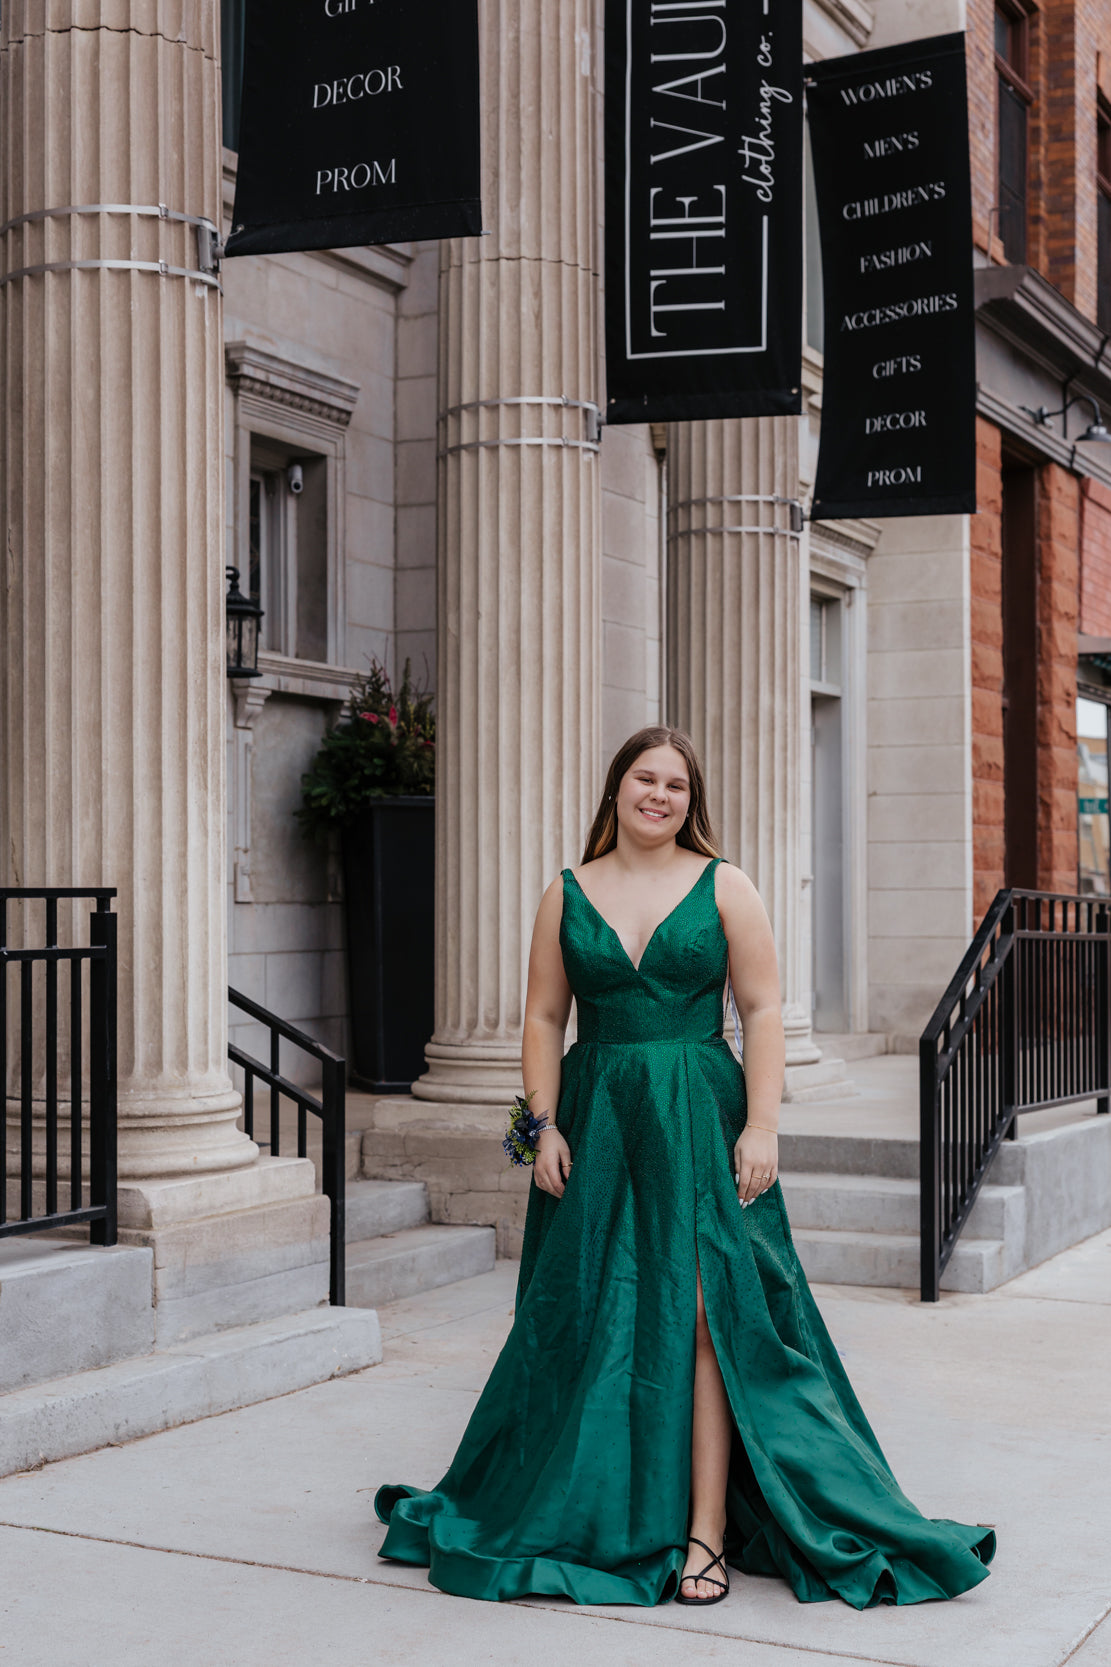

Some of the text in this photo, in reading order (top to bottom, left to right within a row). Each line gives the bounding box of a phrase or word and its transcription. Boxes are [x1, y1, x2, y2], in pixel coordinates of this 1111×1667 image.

[312, 65, 404, 109] DECOR
[841, 70, 933, 106] WOMEN'S
[738, 31, 793, 203] clothing co.
[863, 131, 920, 160] MEN'S
[316, 158, 397, 195] PROM
[842, 181, 946, 221] CHILDREN'S
[650, 184, 727, 337] THE
[860, 241, 933, 274] FASHION
[841, 293, 958, 332] ACCESSORIES
[872, 354, 922, 379] GIFTS
[865, 409, 927, 435] DECOR
[867, 465, 922, 488] PROM
